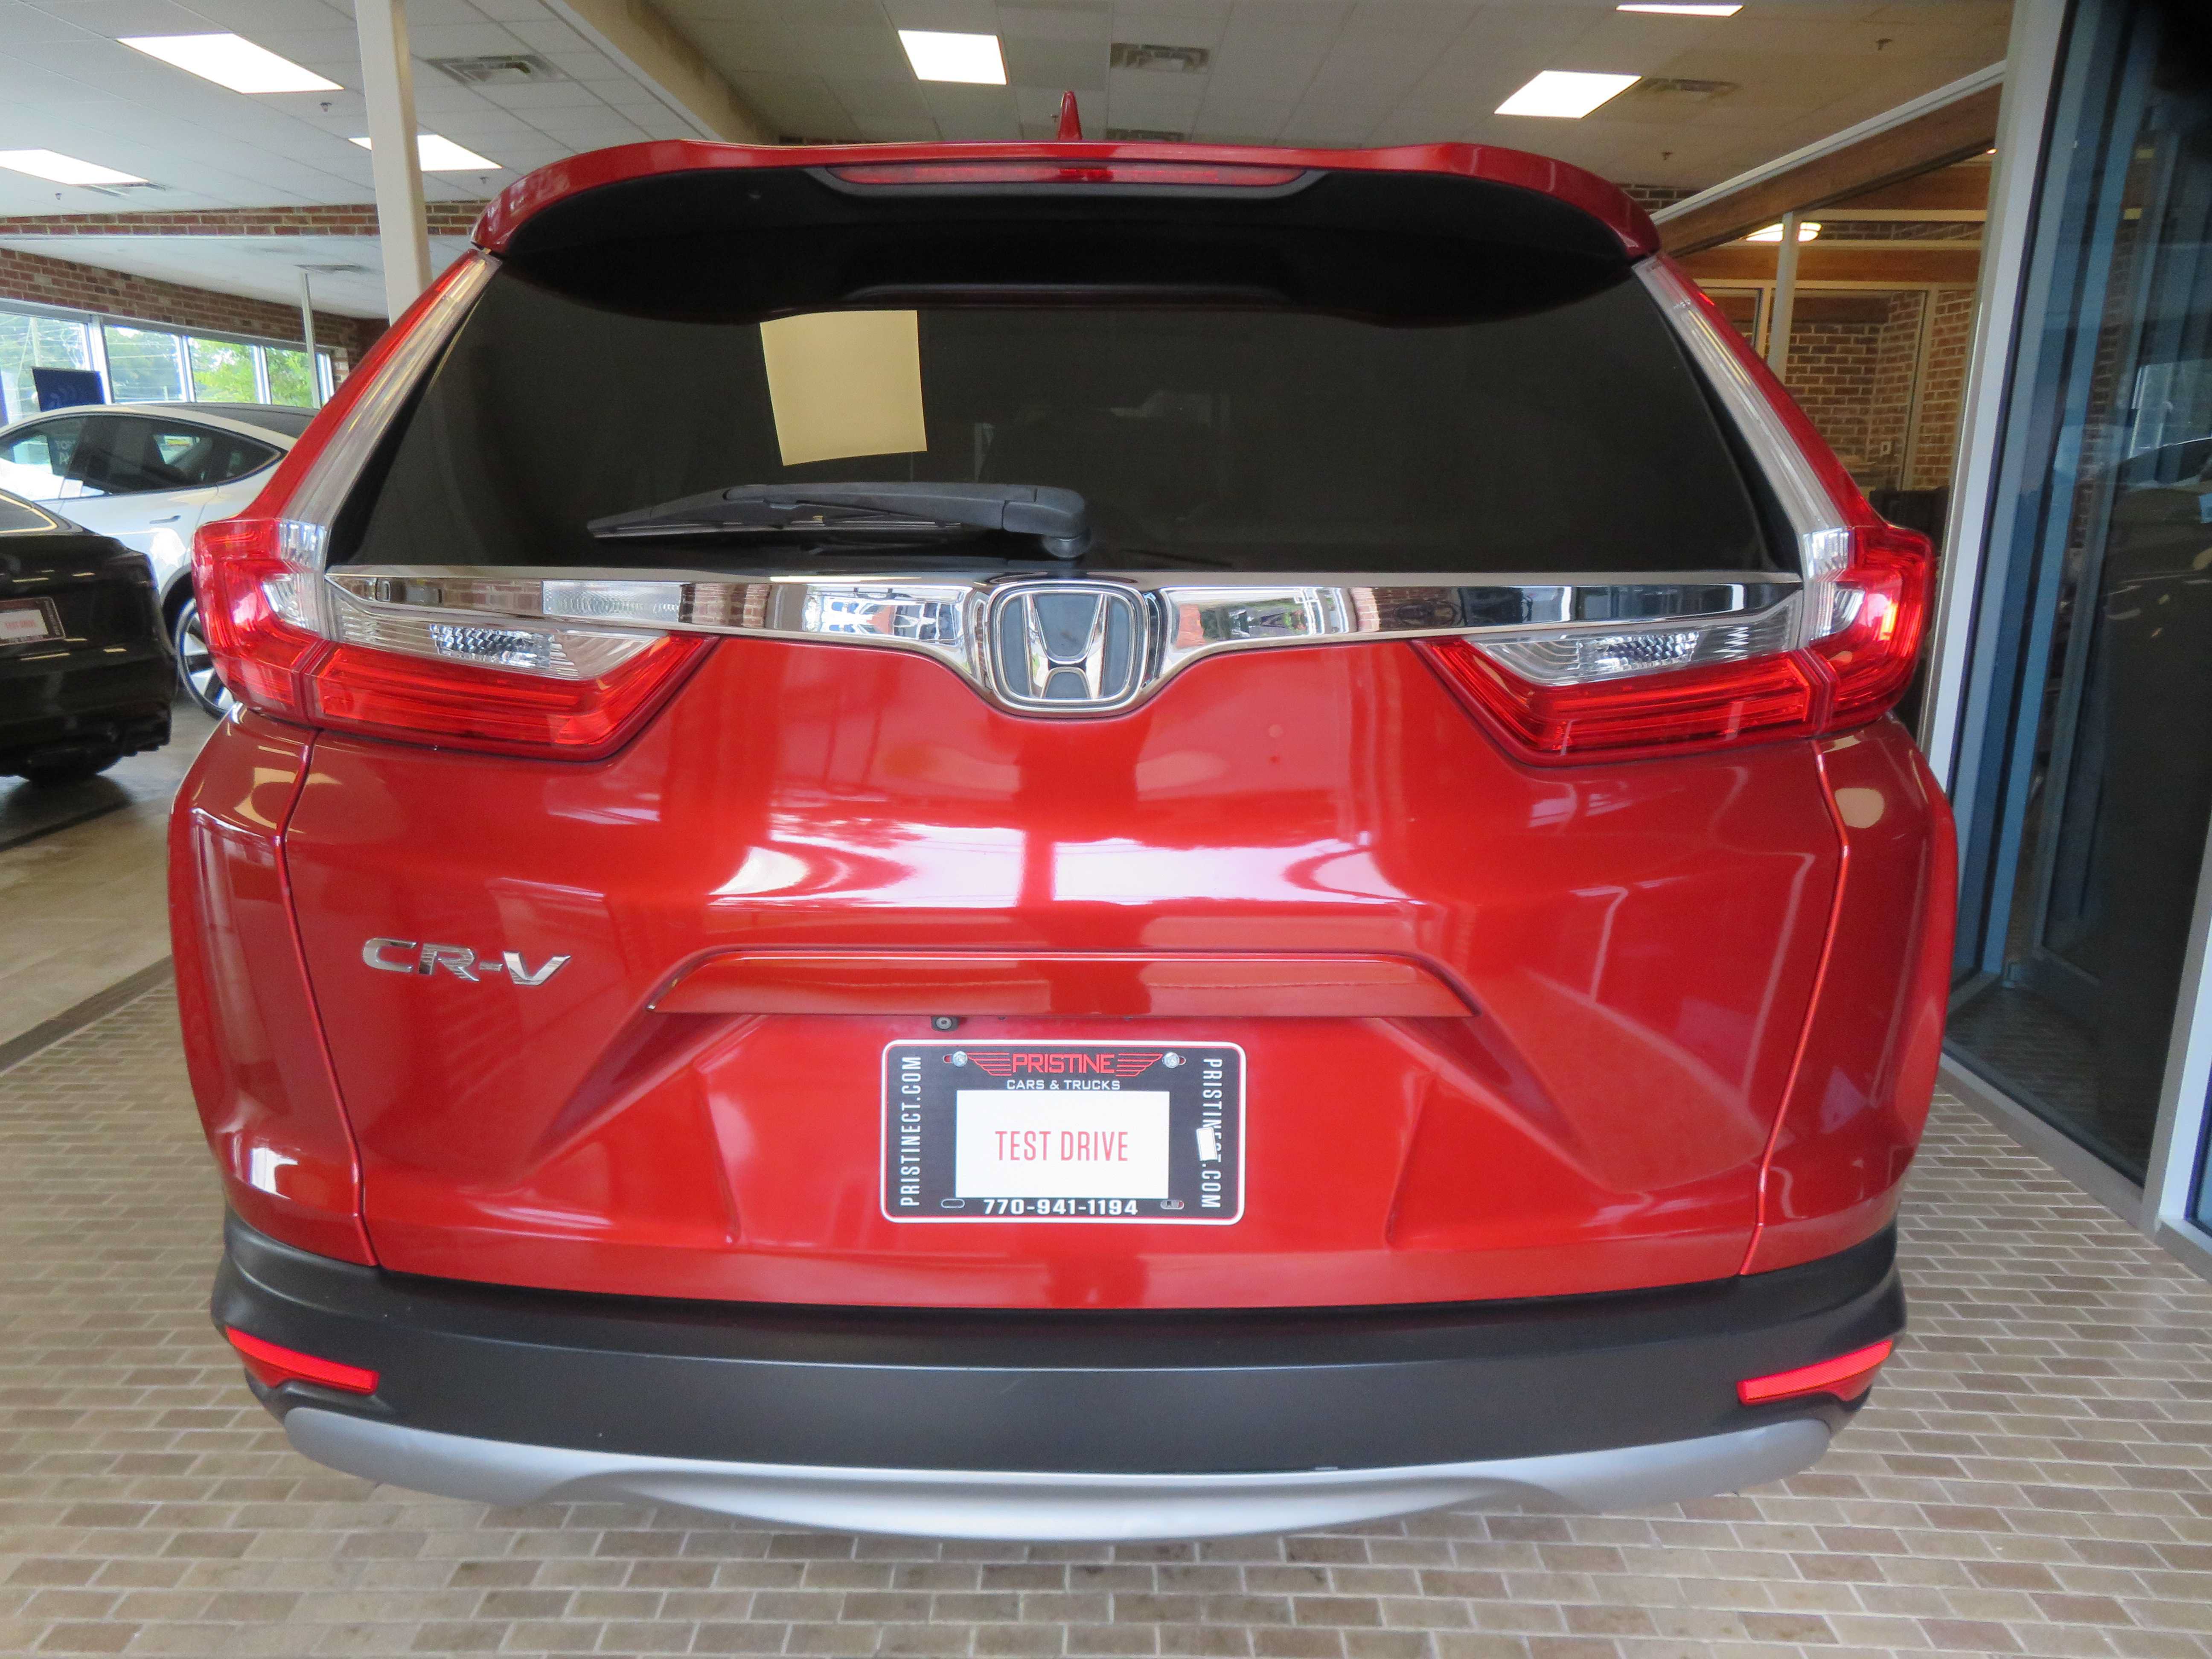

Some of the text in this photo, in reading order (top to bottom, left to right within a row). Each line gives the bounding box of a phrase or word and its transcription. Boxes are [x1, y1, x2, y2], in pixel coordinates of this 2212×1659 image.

[361, 937, 571, 986] CR-V
[1012, 1053, 1115, 1074] PRISTINE
[1007, 1080, 1121, 1090] CARS & TRUCKS
[900, 1057, 922, 1206] PRISTINECT.COM
[995, 1131, 1128, 1161] TEST DRIVE
[983, 1199, 1138, 1215] 770-941-1194
